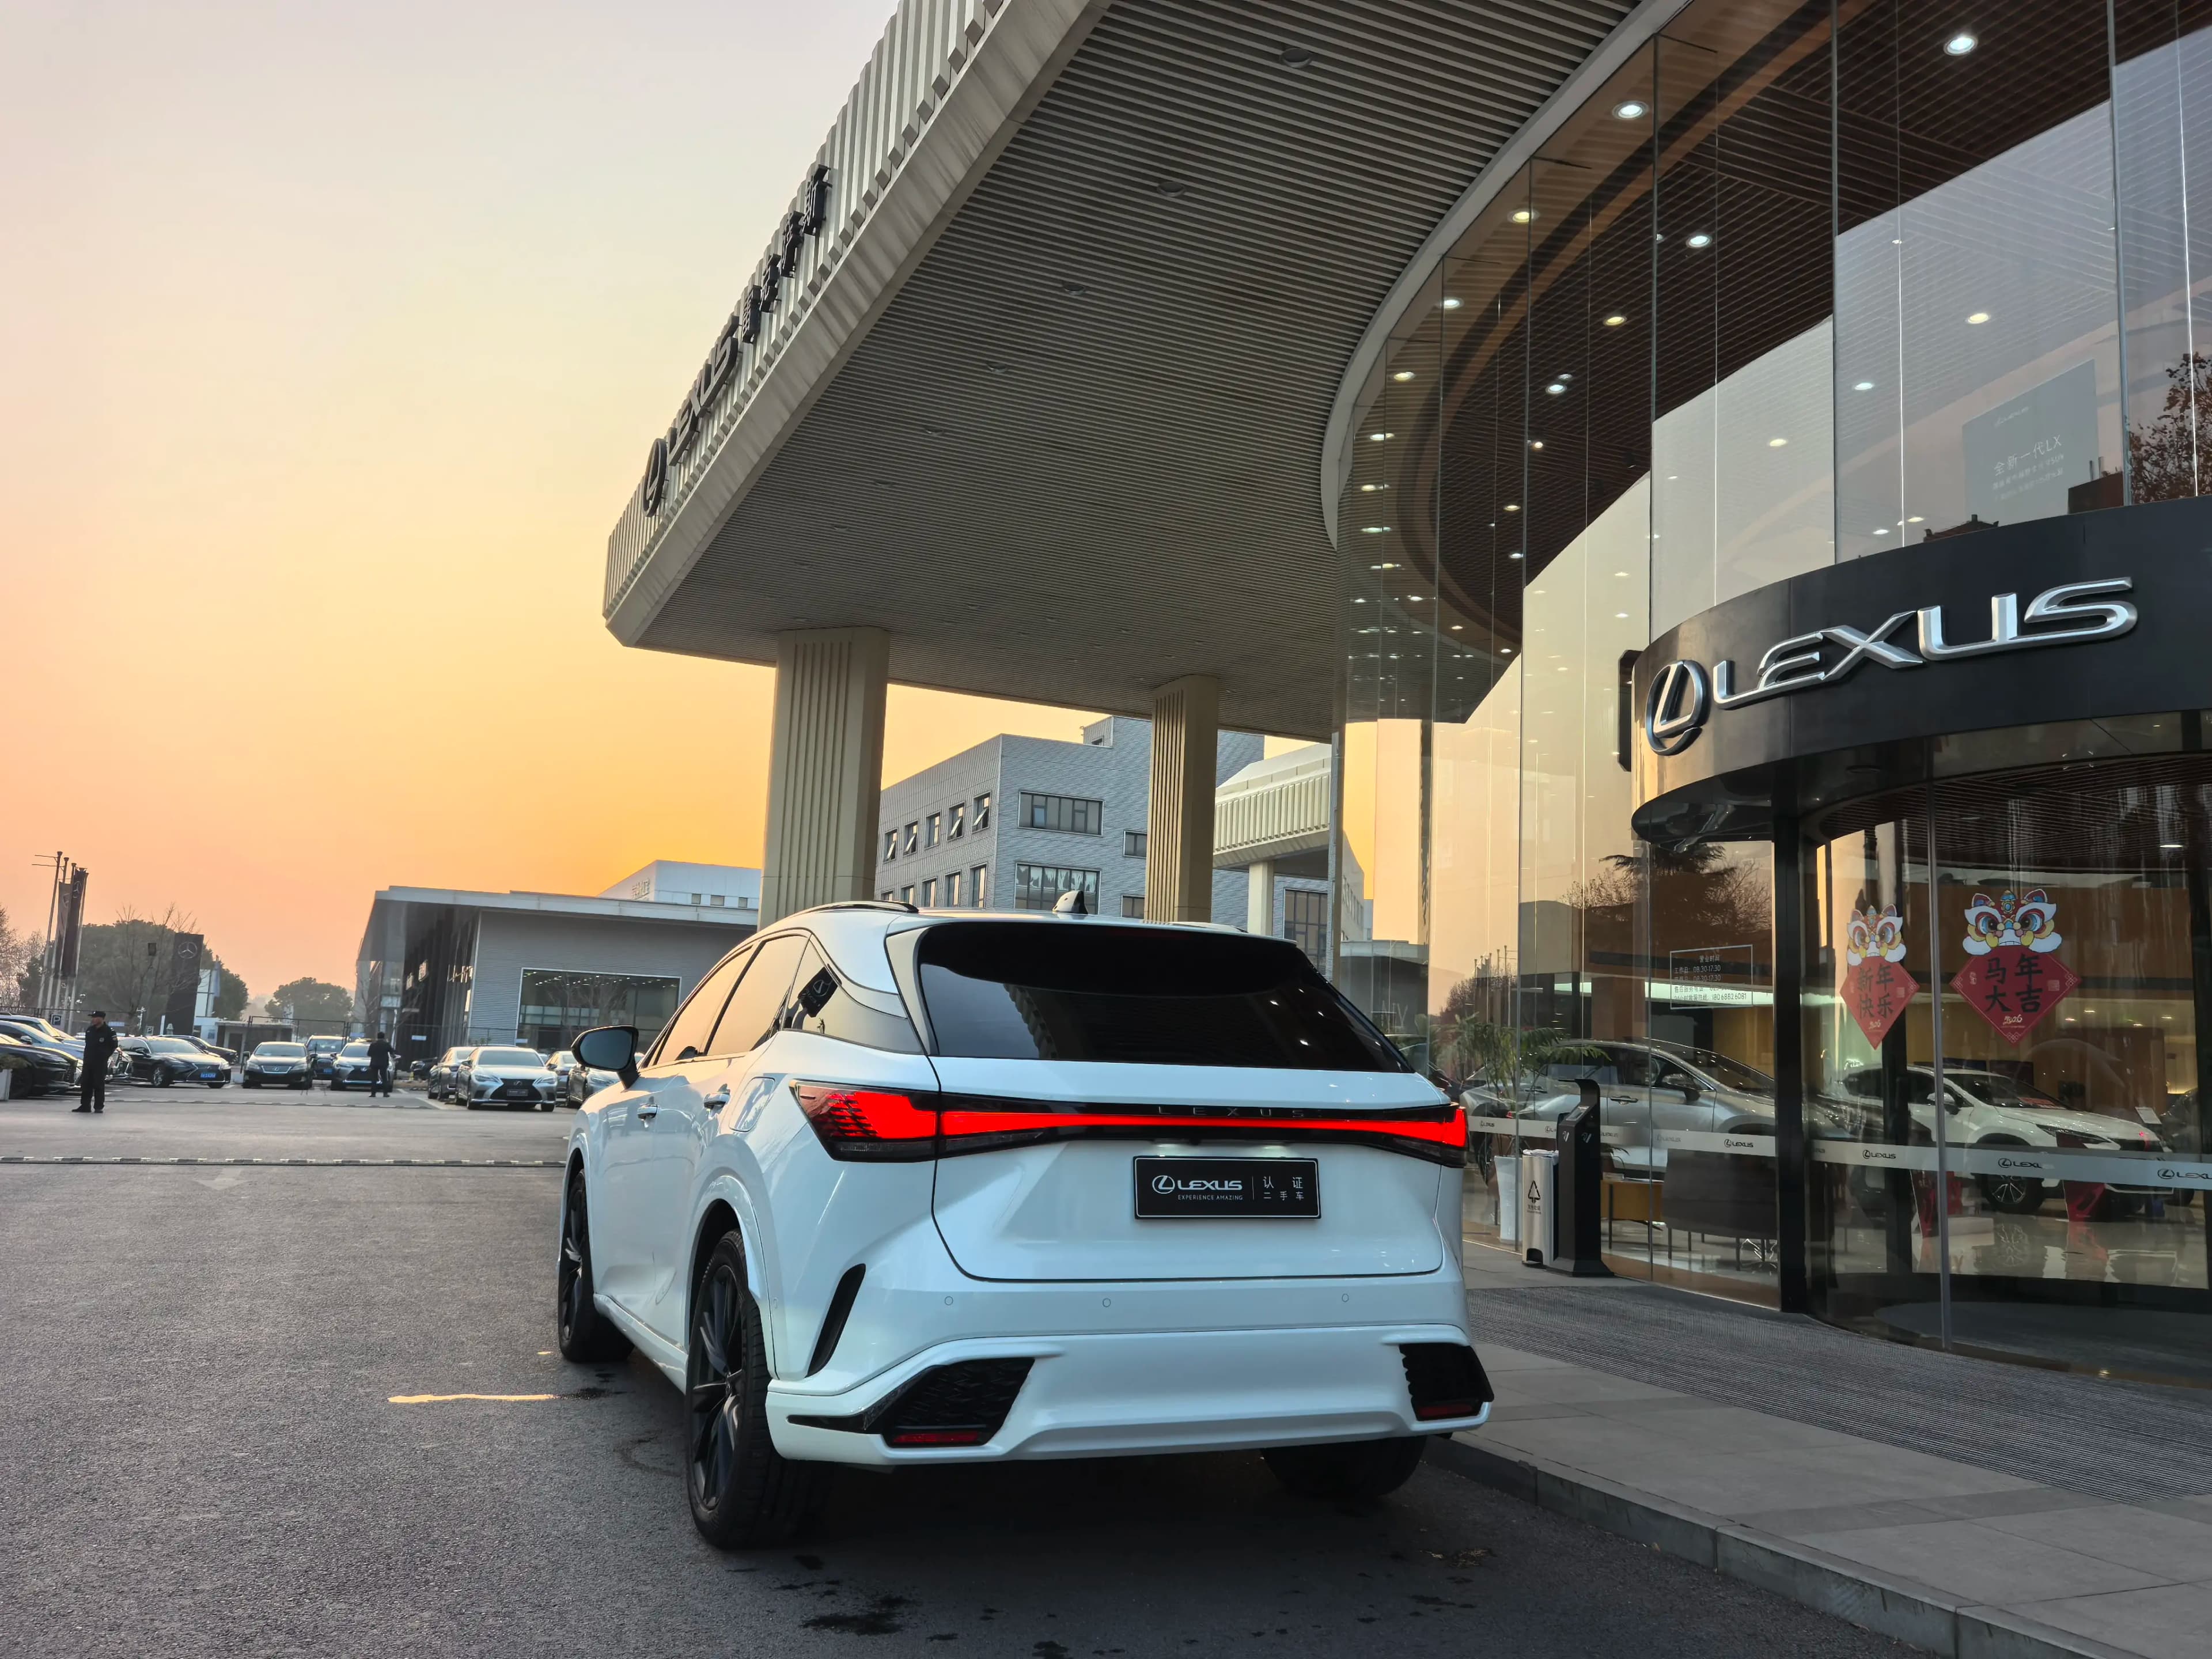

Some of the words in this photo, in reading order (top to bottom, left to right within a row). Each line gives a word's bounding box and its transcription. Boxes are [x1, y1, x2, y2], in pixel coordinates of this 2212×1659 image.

[1713, 576, 2138, 711] LEXUS
[1858, 963, 1894, 992] 新年
[1985, 953, 2043, 986] 马年
[1859, 993, 1894, 1019] 快乐
[1985, 984, 2043, 1013] 大吉
[1158, 1105, 1304, 1118] LEXUS
[1177, 1180, 1243, 1191] LEXUS
[1263, 1176, 1304, 1189] 认证
[1263, 1191, 1304, 1202] 二手车
